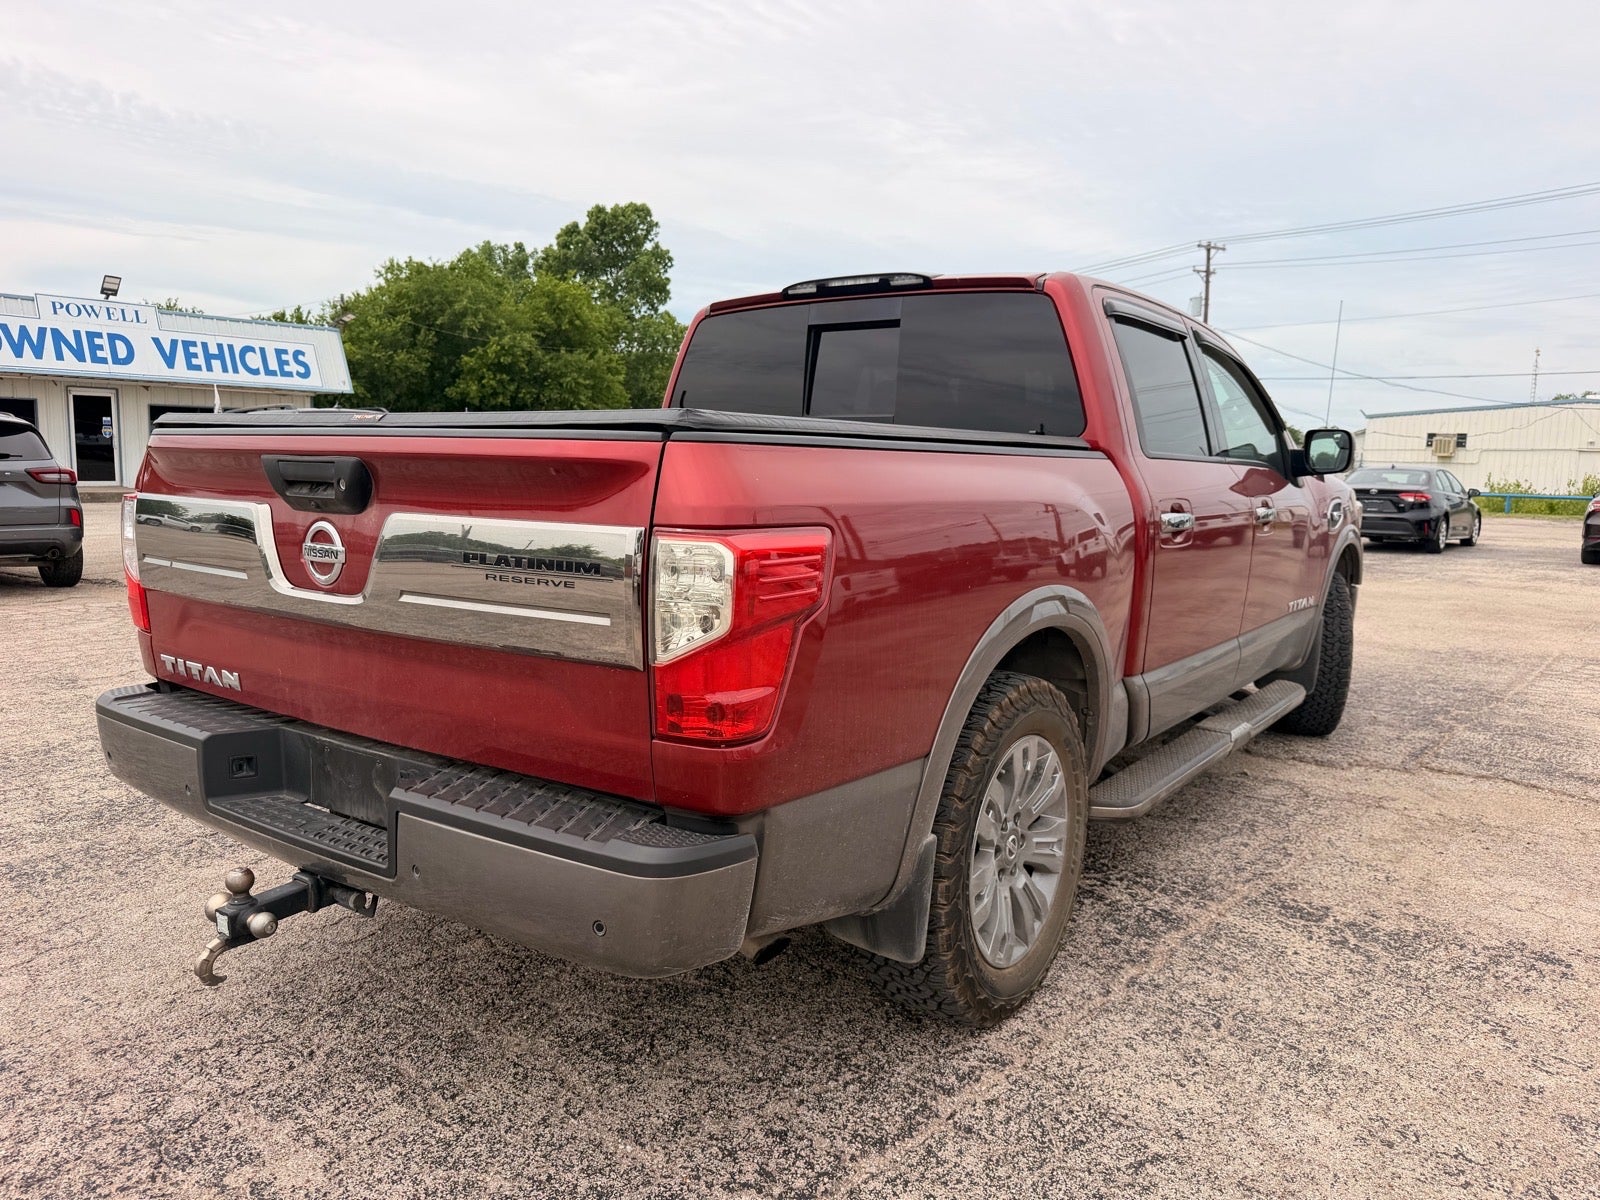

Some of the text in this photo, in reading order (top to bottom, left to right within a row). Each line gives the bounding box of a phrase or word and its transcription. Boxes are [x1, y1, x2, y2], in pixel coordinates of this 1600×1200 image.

[51, 301, 148, 324] POWELL
[0, 323, 311, 379] WNED VEHICLES
[304, 545, 339, 560] NISSAN
[462, 551, 601, 575] PLATINUM
[485, 573, 576, 589] RESERVE
[1288, 596, 1314, 613] TITAN
[160, 654, 241, 692] TITAN
